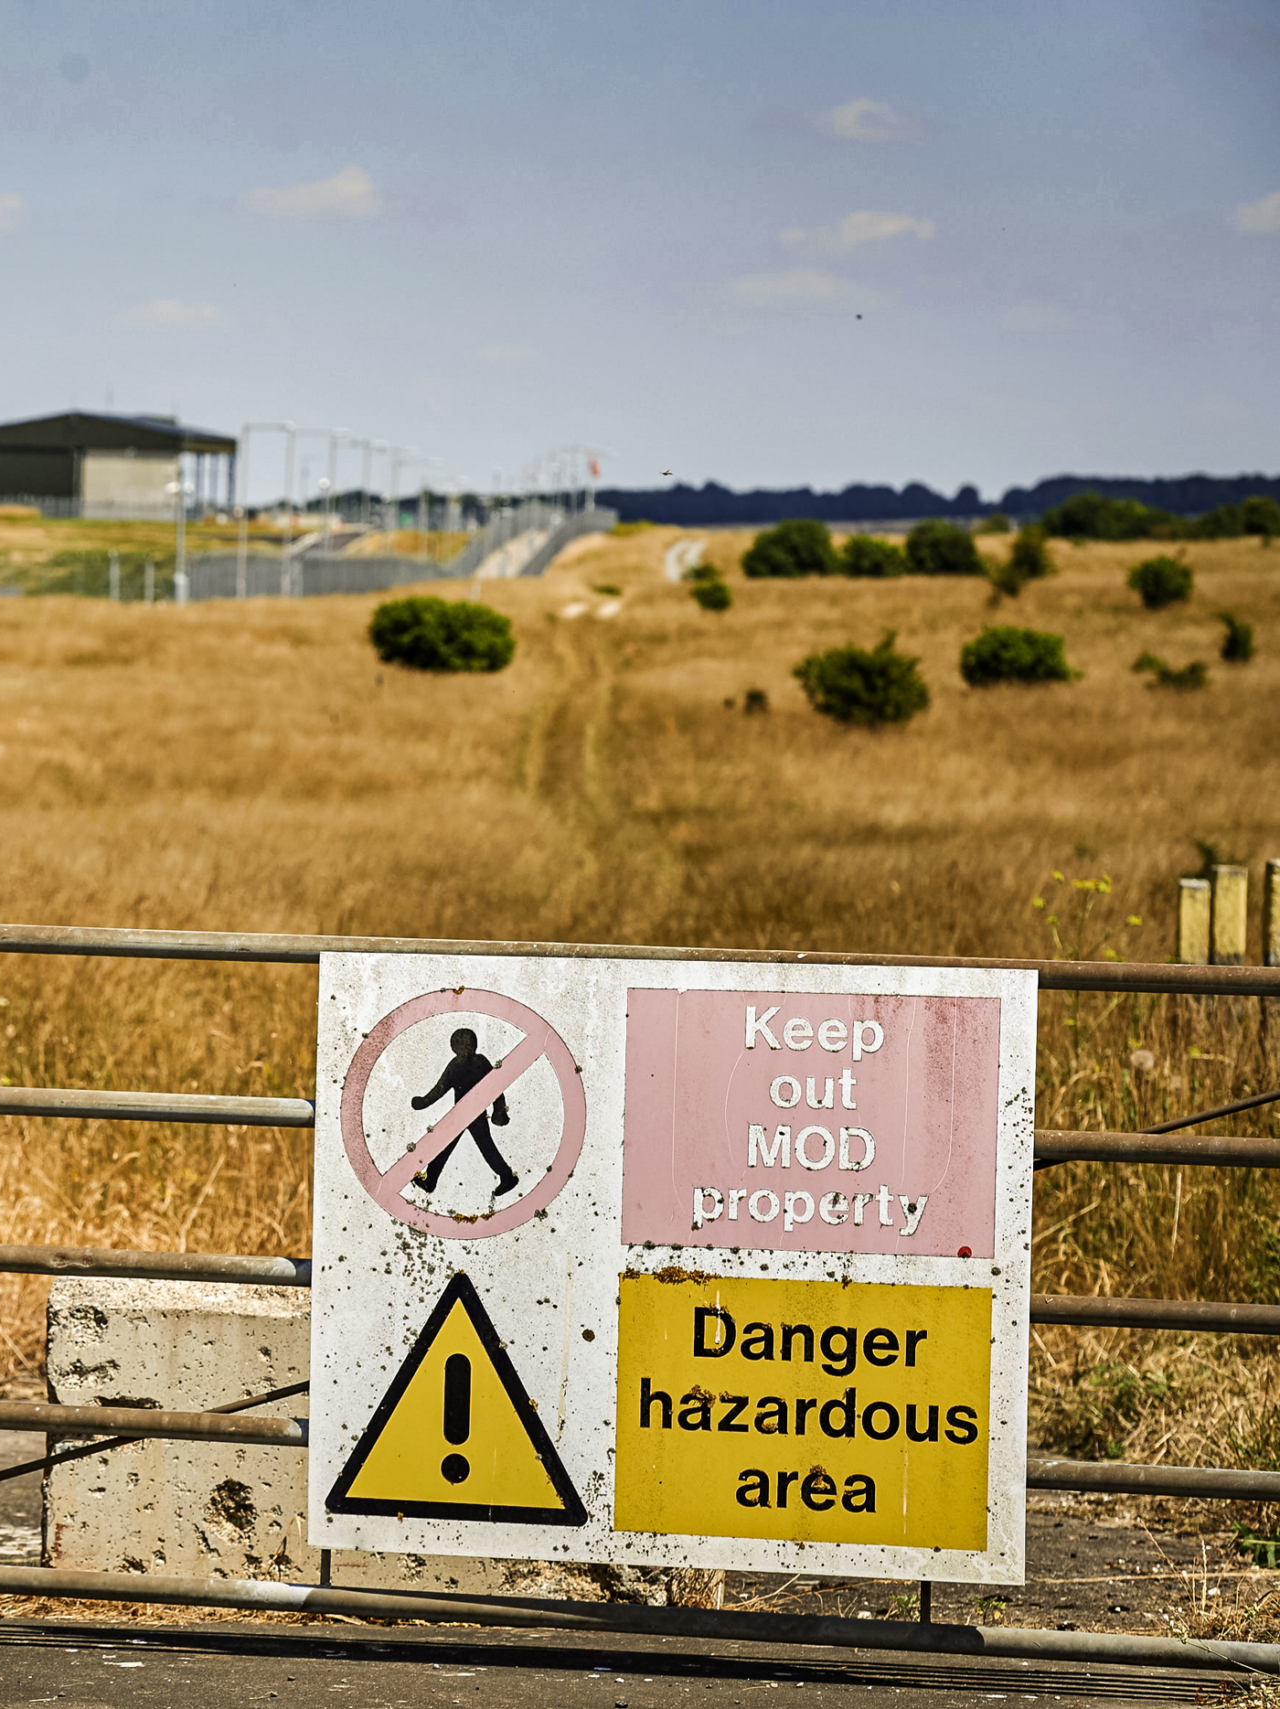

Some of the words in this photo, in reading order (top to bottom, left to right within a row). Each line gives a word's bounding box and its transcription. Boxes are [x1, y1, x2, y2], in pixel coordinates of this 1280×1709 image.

[744, 1005, 885, 1062] Keep
[768, 1067, 858, 1110] out
[746, 1123, 877, 1172] MOD
[691, 1184, 930, 1237] property
[692, 1306, 928, 1376] Danger
[638, 1377, 980, 1446] hazardous
[734, 1467, 877, 1514] area
